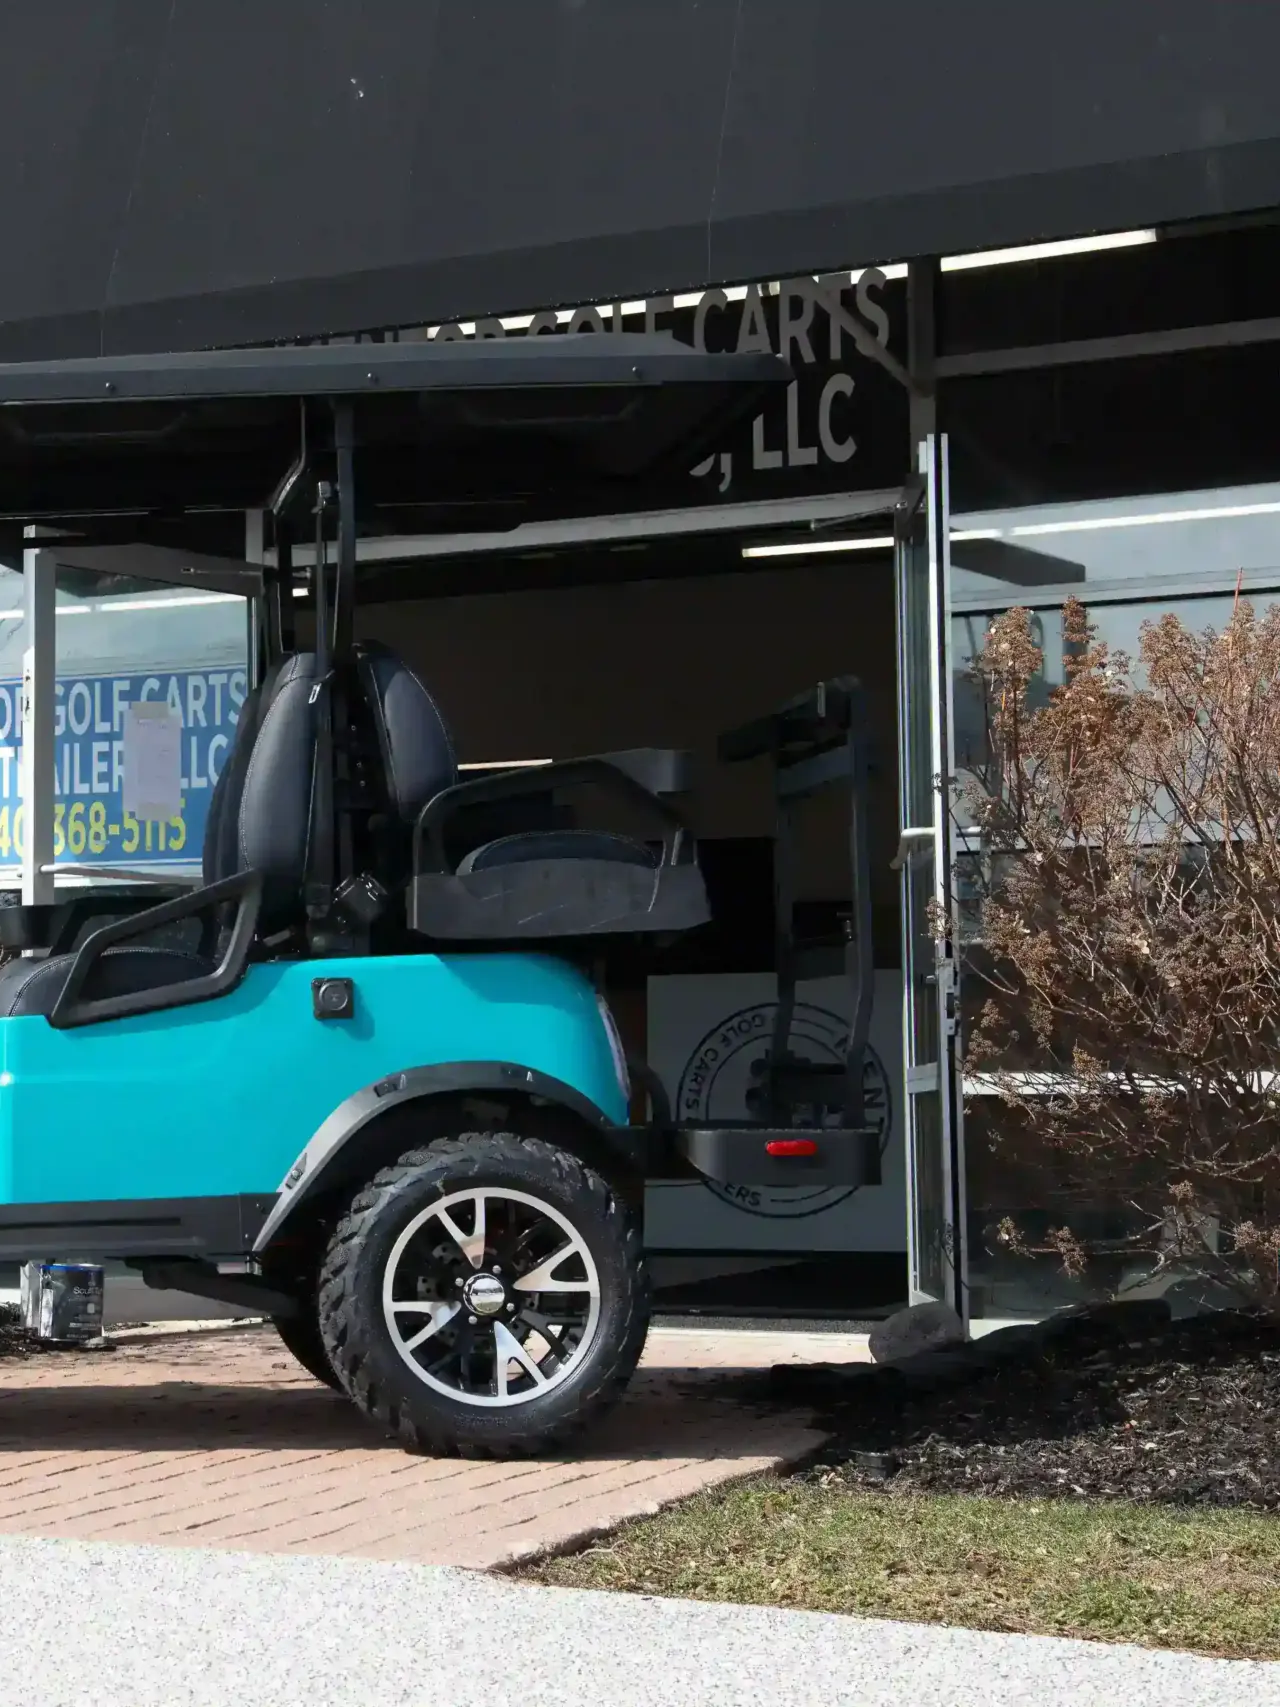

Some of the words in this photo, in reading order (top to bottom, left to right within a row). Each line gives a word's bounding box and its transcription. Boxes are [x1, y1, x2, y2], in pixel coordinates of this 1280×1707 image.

[693, 267, 890, 366] CARTS
[752, 373, 858, 470] LLC
[180, 733, 229, 790] LC
[719, 1013, 766, 1048] GOLF
[685, 1047, 719, 1110] CARTS
